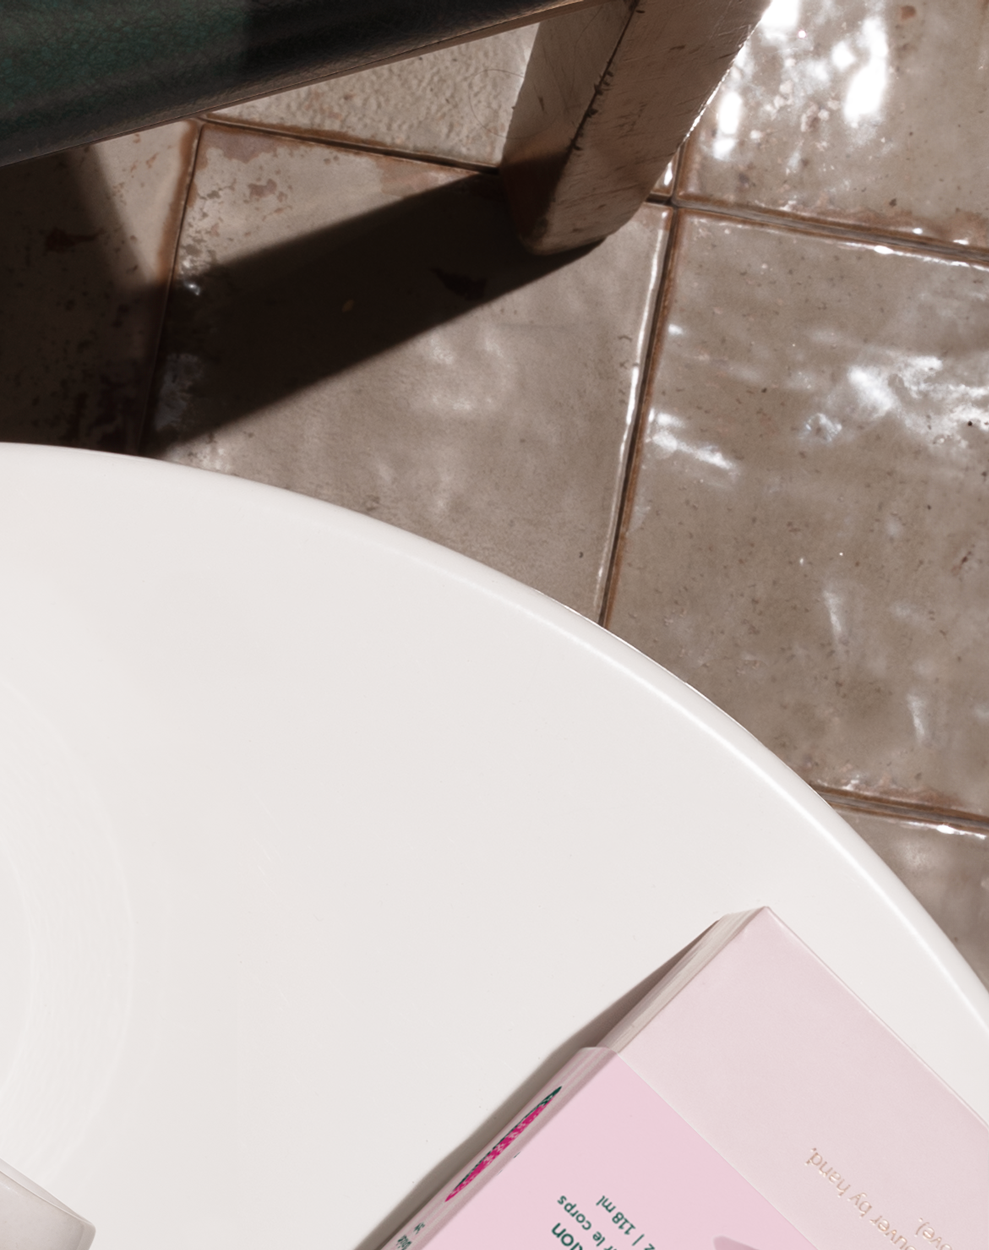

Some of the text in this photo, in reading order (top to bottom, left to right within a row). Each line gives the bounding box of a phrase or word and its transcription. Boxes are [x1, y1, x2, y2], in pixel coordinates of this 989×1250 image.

[805, 1147, 851, 1197] hand.
[557, 1195, 592, 1231] corps
[596, 1195, 616, 1213] ml
[847, 1192, 872, 1218] by
[611, 1211, 636, 1235] 118
[592, 1231, 606, 1247] le
